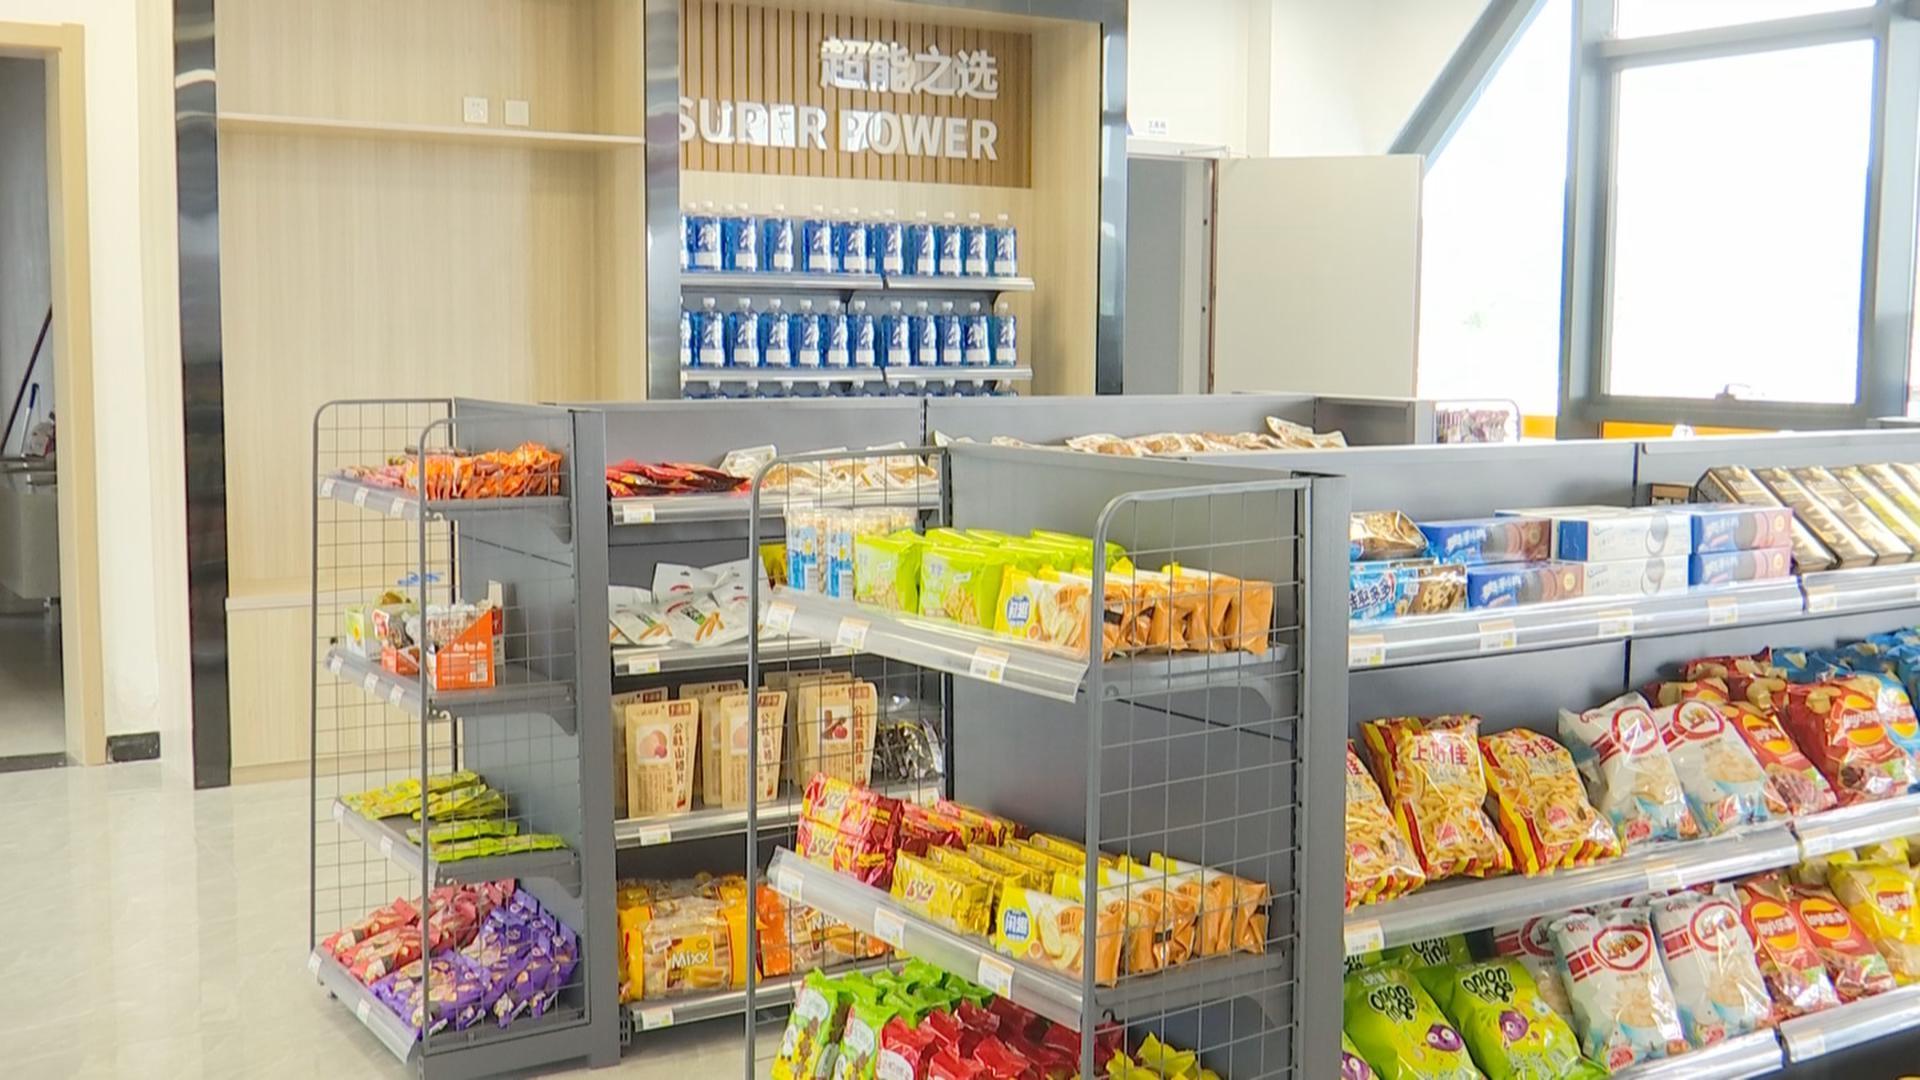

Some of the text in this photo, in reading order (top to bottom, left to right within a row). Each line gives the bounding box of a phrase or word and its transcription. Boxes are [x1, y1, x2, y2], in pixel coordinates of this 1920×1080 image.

[820, 36, 998, 100] 超能之选
[678, 96, 999, 161] SUPER POWER
[671, 951, 710, 969] Mixx
[1462, 967, 1509, 993] onion
[1369, 984, 1410, 1011] onion
